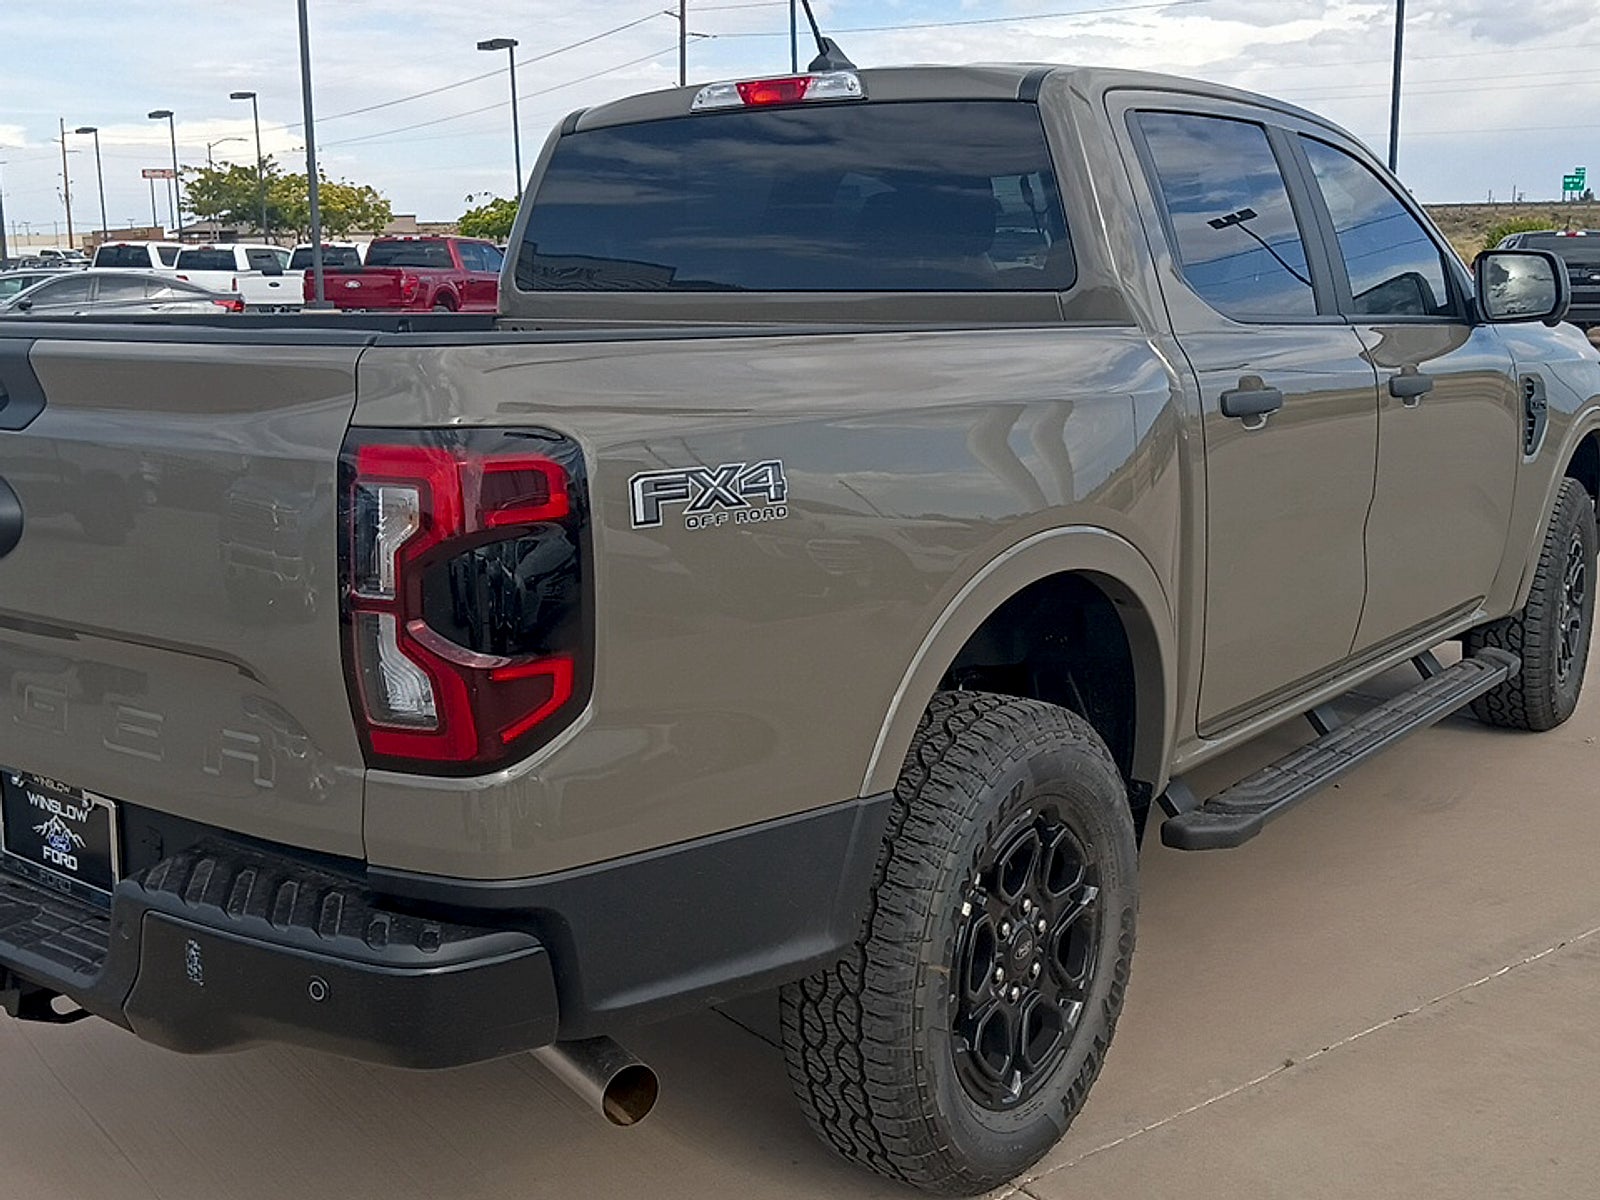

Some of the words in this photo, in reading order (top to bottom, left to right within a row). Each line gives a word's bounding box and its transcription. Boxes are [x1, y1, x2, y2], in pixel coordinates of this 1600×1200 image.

[628, 459, 788, 530] FX4
[685, 511, 728, 531] OFF
[735, 505, 789, 525] ROAD
[26, 790, 89, 824] WINSLOW
[42, 845, 79, 872] FORD
